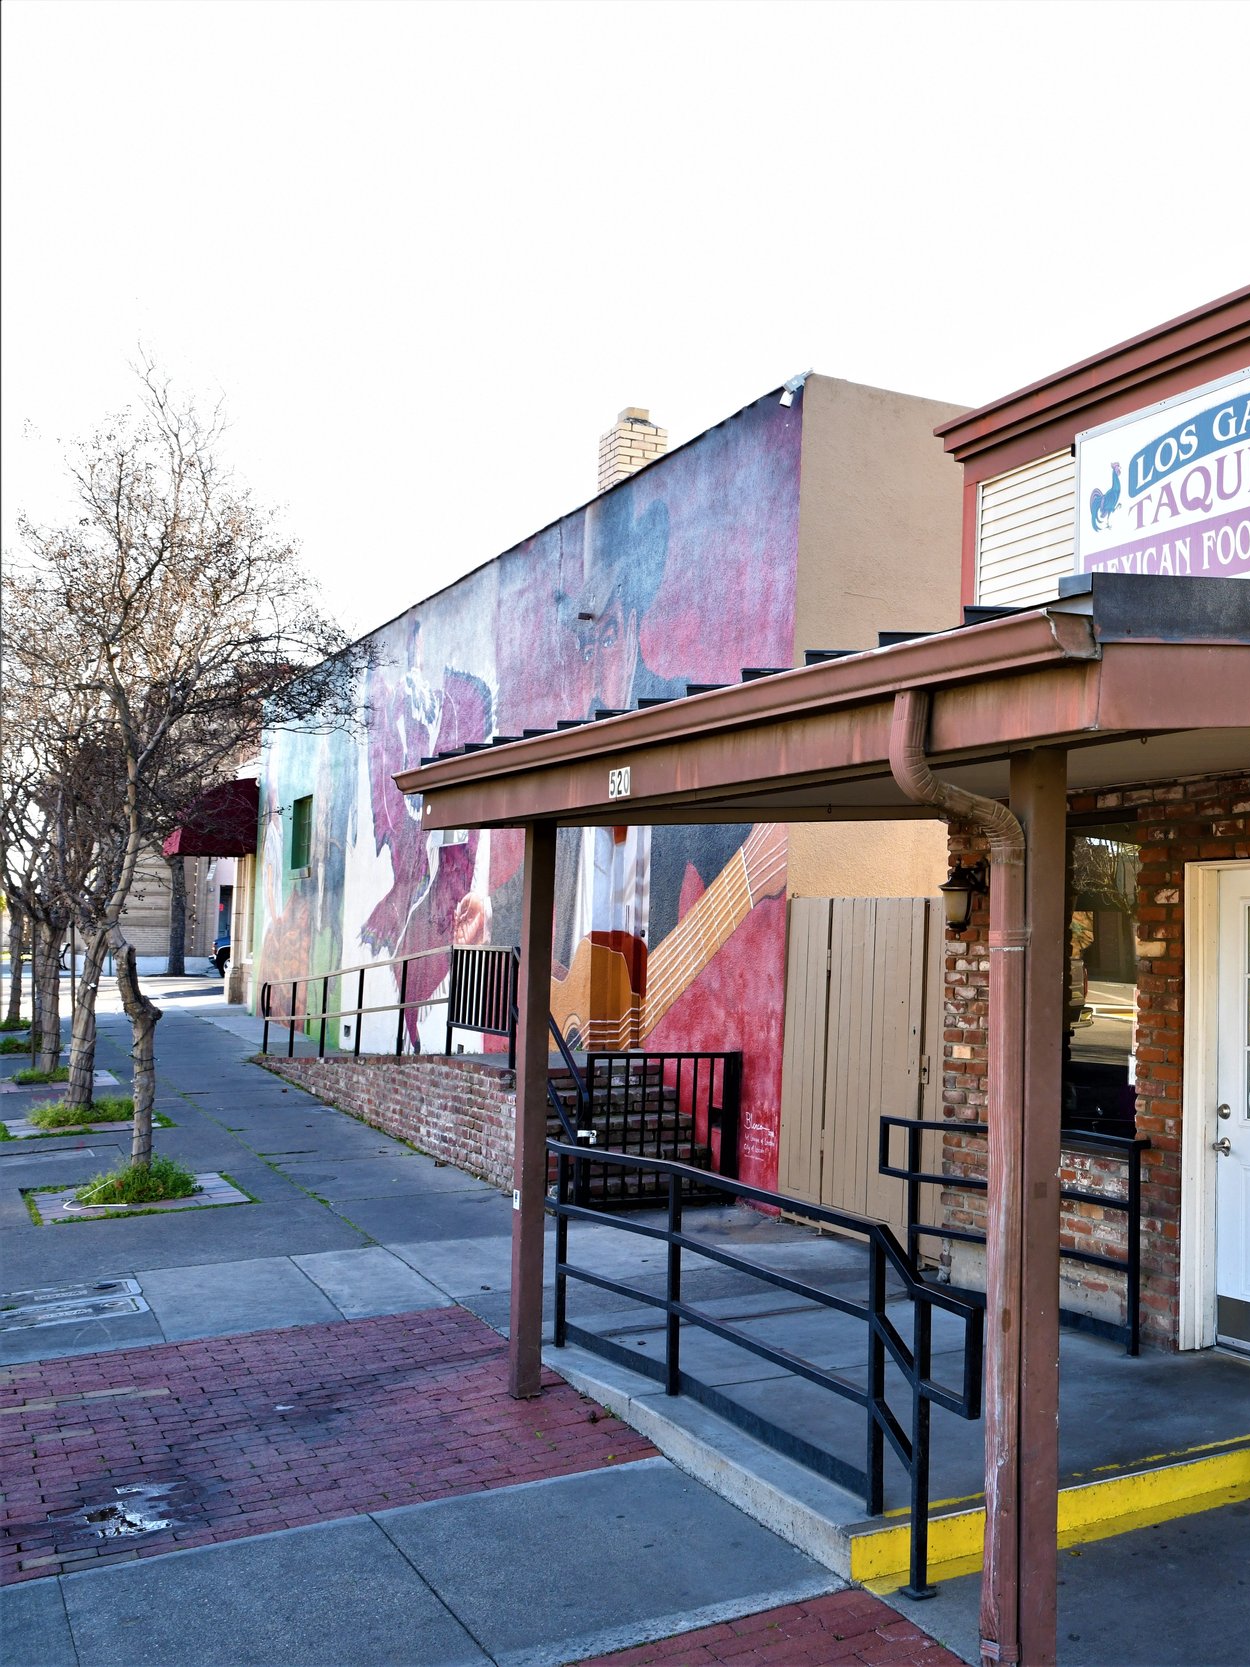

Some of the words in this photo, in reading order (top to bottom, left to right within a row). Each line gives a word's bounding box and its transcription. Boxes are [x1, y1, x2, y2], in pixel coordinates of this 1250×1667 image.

[1134, 423, 1200, 488] LOS
[1091, 537, 1192, 576] XICAN
[610, 769, 629, 796] 520
